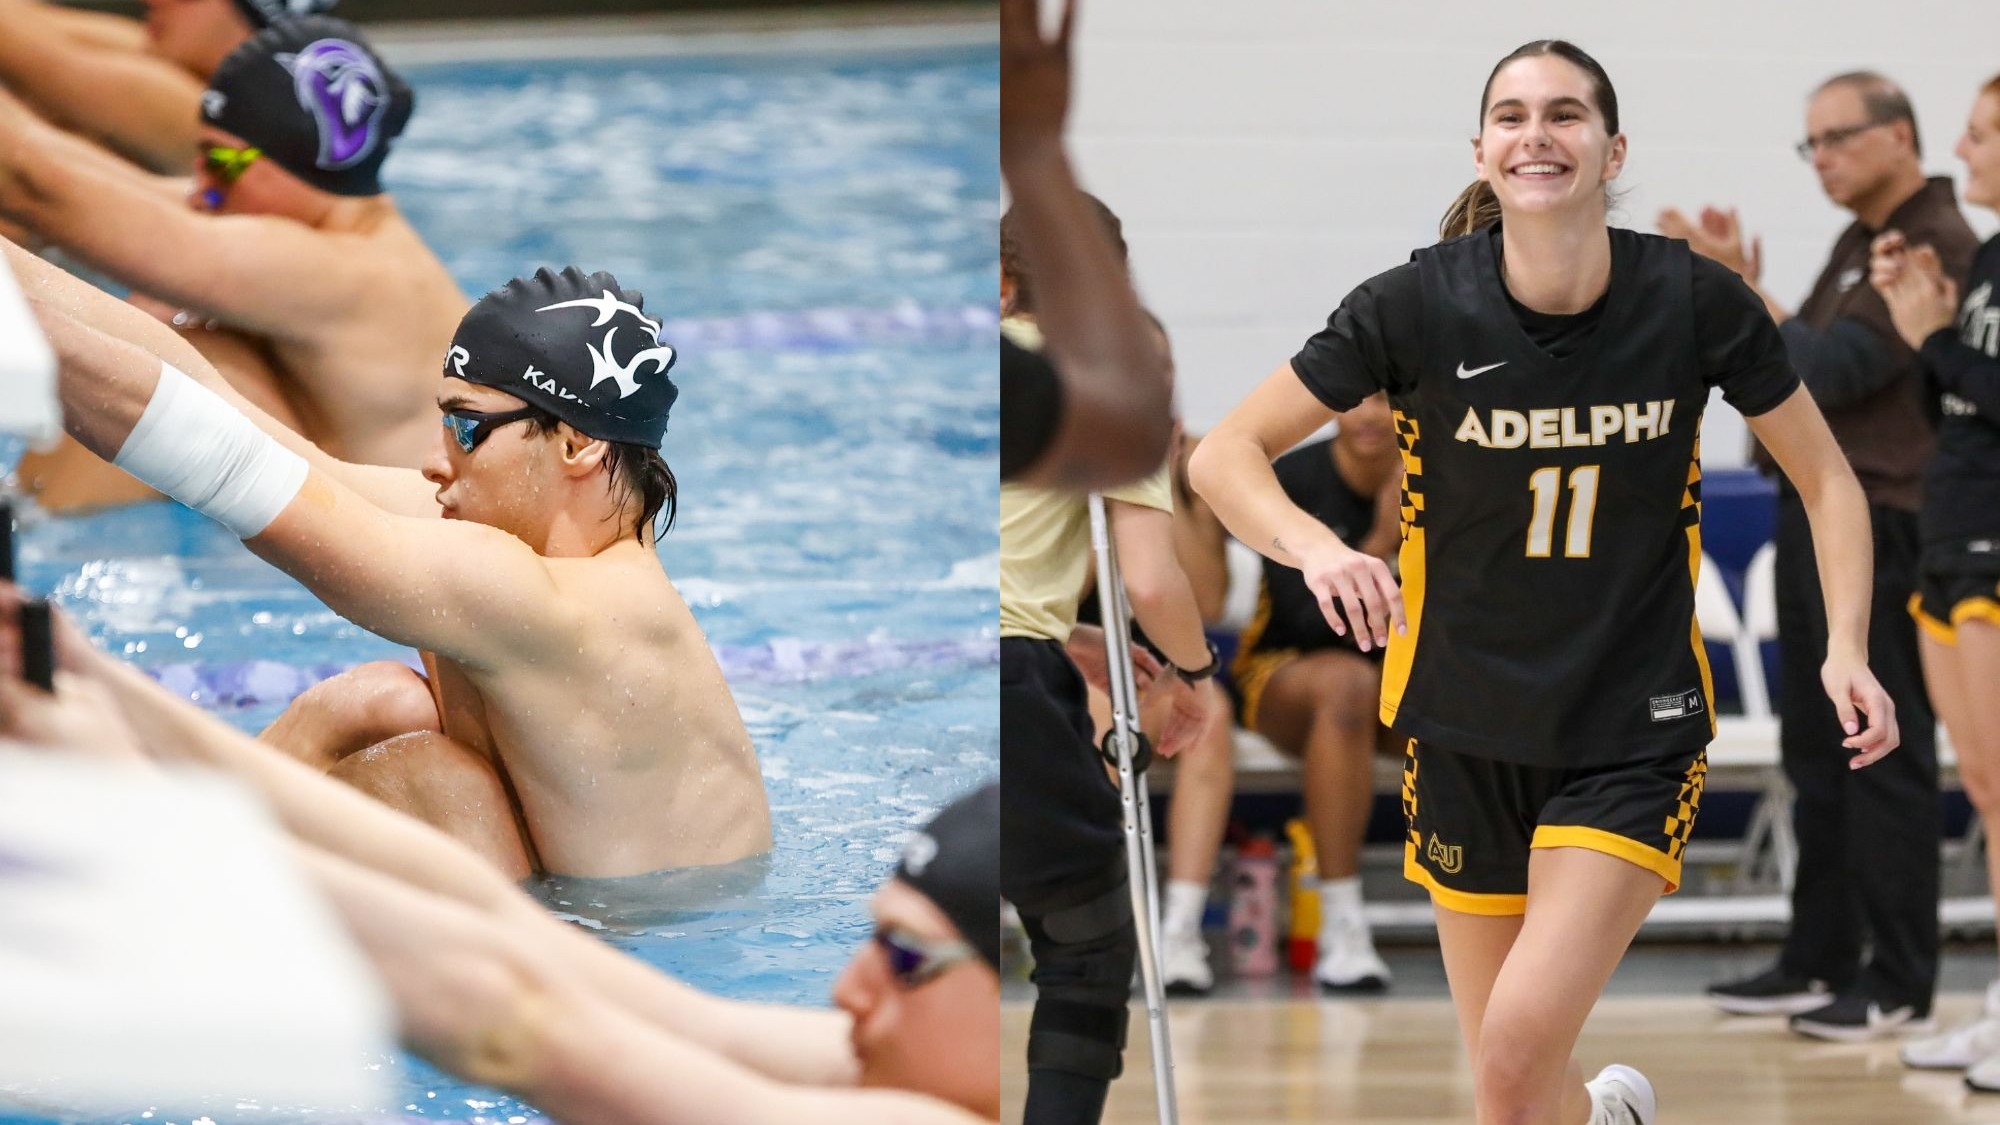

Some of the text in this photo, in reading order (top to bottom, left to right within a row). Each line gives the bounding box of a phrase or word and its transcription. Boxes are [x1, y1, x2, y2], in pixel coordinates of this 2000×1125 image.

[1454, 399, 1676, 449] ADELPHI
[1525, 465, 1600, 558] 11
[1688, 696, 1698, 709] M
[1427, 832, 1463, 874] AU
